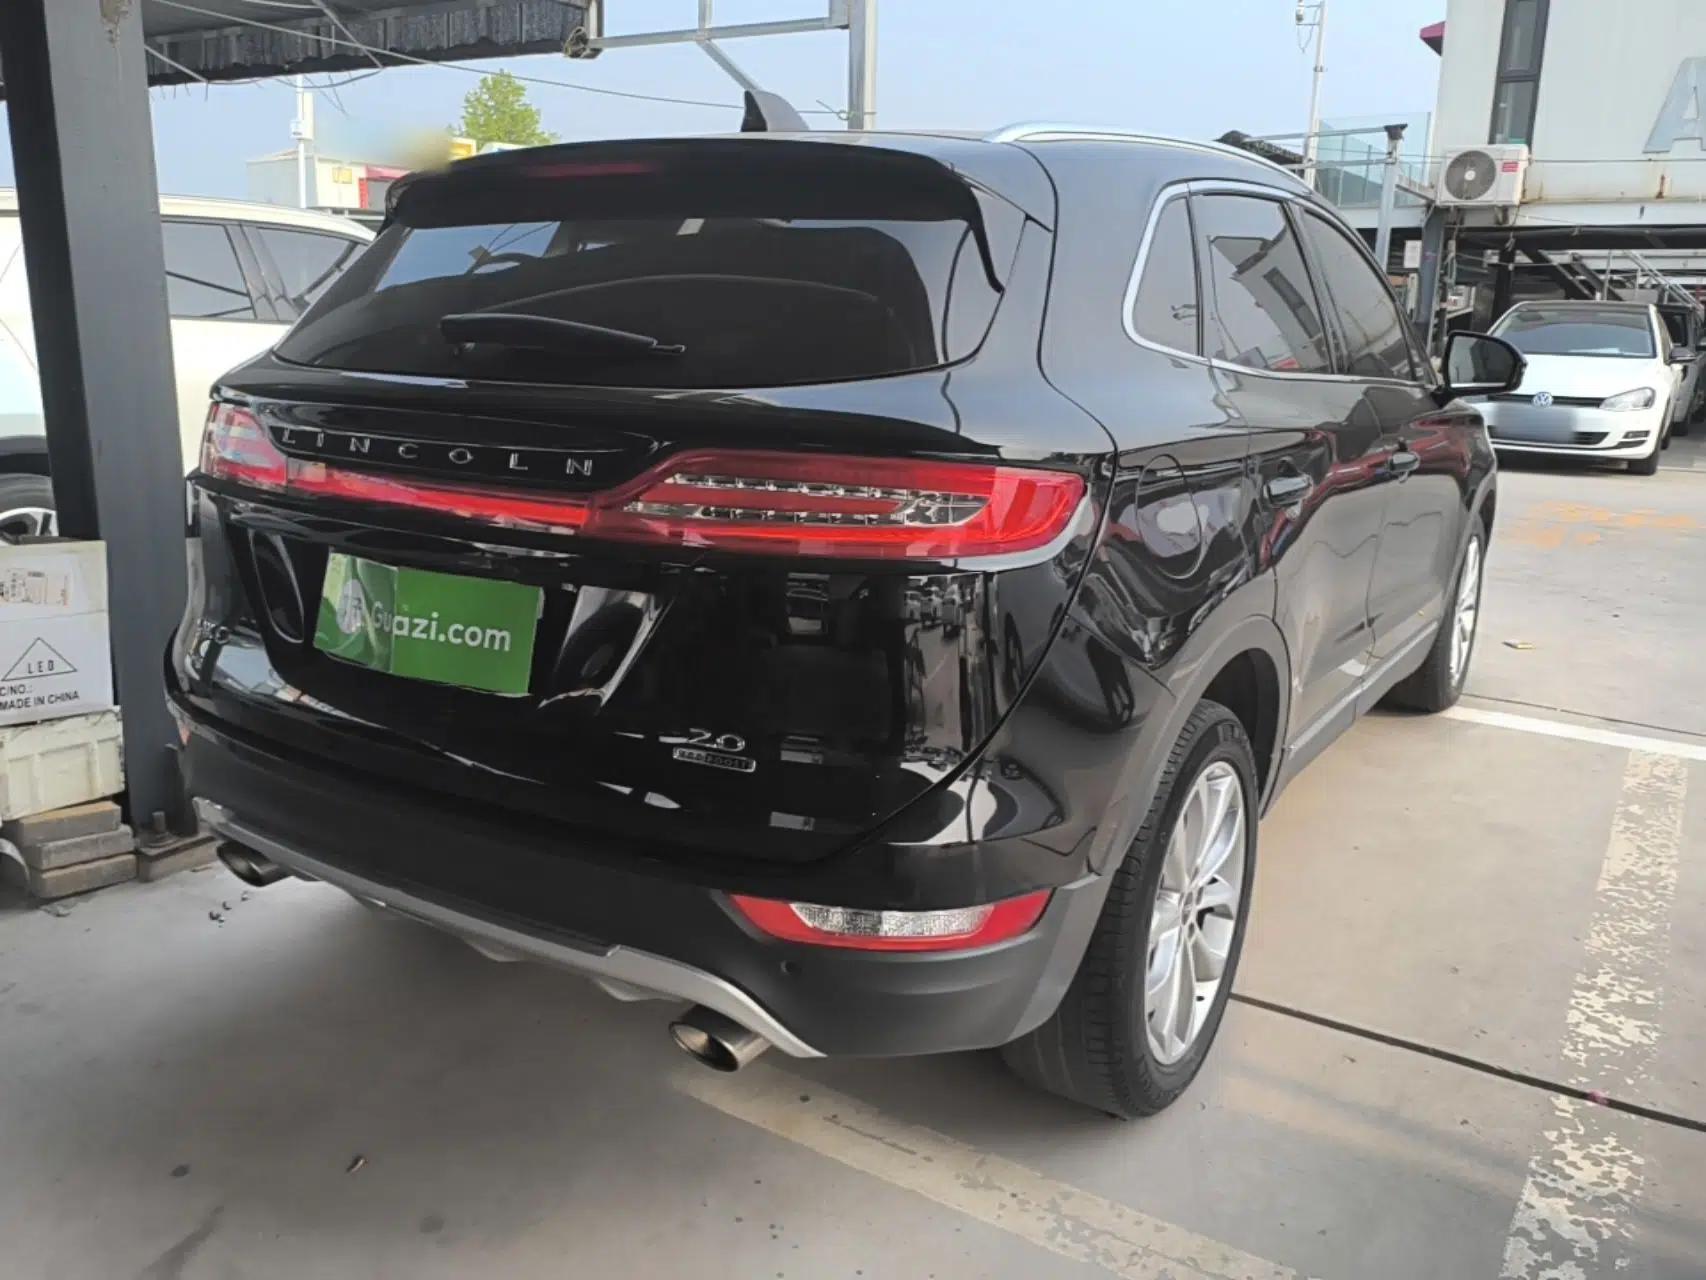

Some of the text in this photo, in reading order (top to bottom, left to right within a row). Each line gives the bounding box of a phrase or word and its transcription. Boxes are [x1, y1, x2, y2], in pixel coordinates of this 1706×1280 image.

[282, 427, 593, 476] LINCOLN
[371, 601, 512, 652] Guazi.com
[28, 659, 55, 674] LED
[0, 690, 80, 711] MADE IN CHINA
